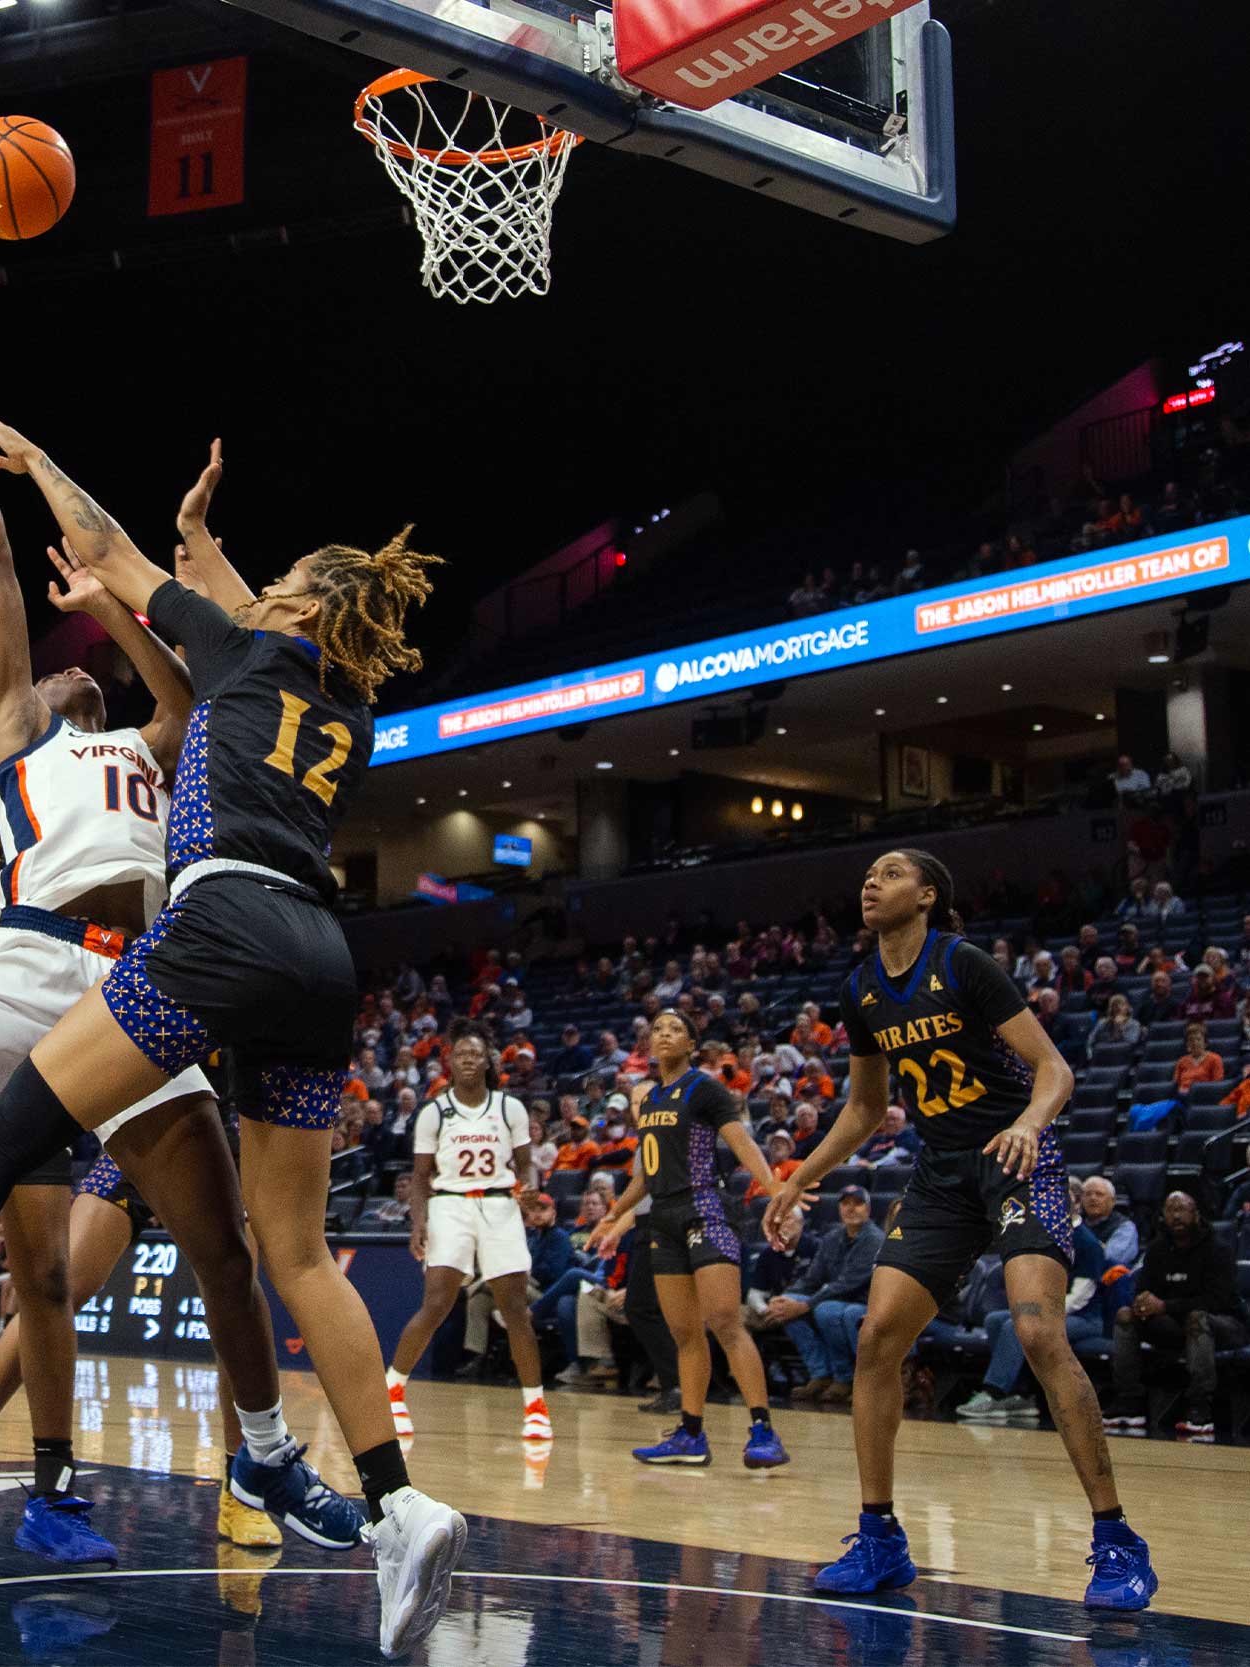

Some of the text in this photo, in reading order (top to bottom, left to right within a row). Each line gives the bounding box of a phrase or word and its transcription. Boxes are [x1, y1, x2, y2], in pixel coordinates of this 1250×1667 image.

[674, 0, 897, 88] eFarm
[178, 152, 215, 198] 11
[920, 544, 1222, 628] THE JASON HELMINTOLLER TEAM OF
[443, 716, 463, 734] THE
[464, 709, 502, 730] JASON
[586, 681, 620, 702] TEAM
[621, 675, 641, 694] OF
[263, 689, 353, 807] 12
[104, 764, 160, 824] 10
[873, 1012, 964, 1052] PIRATES
[899, 1049, 988, 1118] 22
[450, 1134, 501, 1145] VIRGINIA
[643, 1132, 659, 1176] 0
[458, 1149, 496, 1177] 23
[132, 1243, 178, 1276] 2:20
[103, 1296, 114, 1313] 4
[129, 1296, 162, 1316] POSS
[135, 1276, 163, 1296] P 1
[178, 1297, 189, 1315] 4
[175, 1321, 185, 1339] 4
